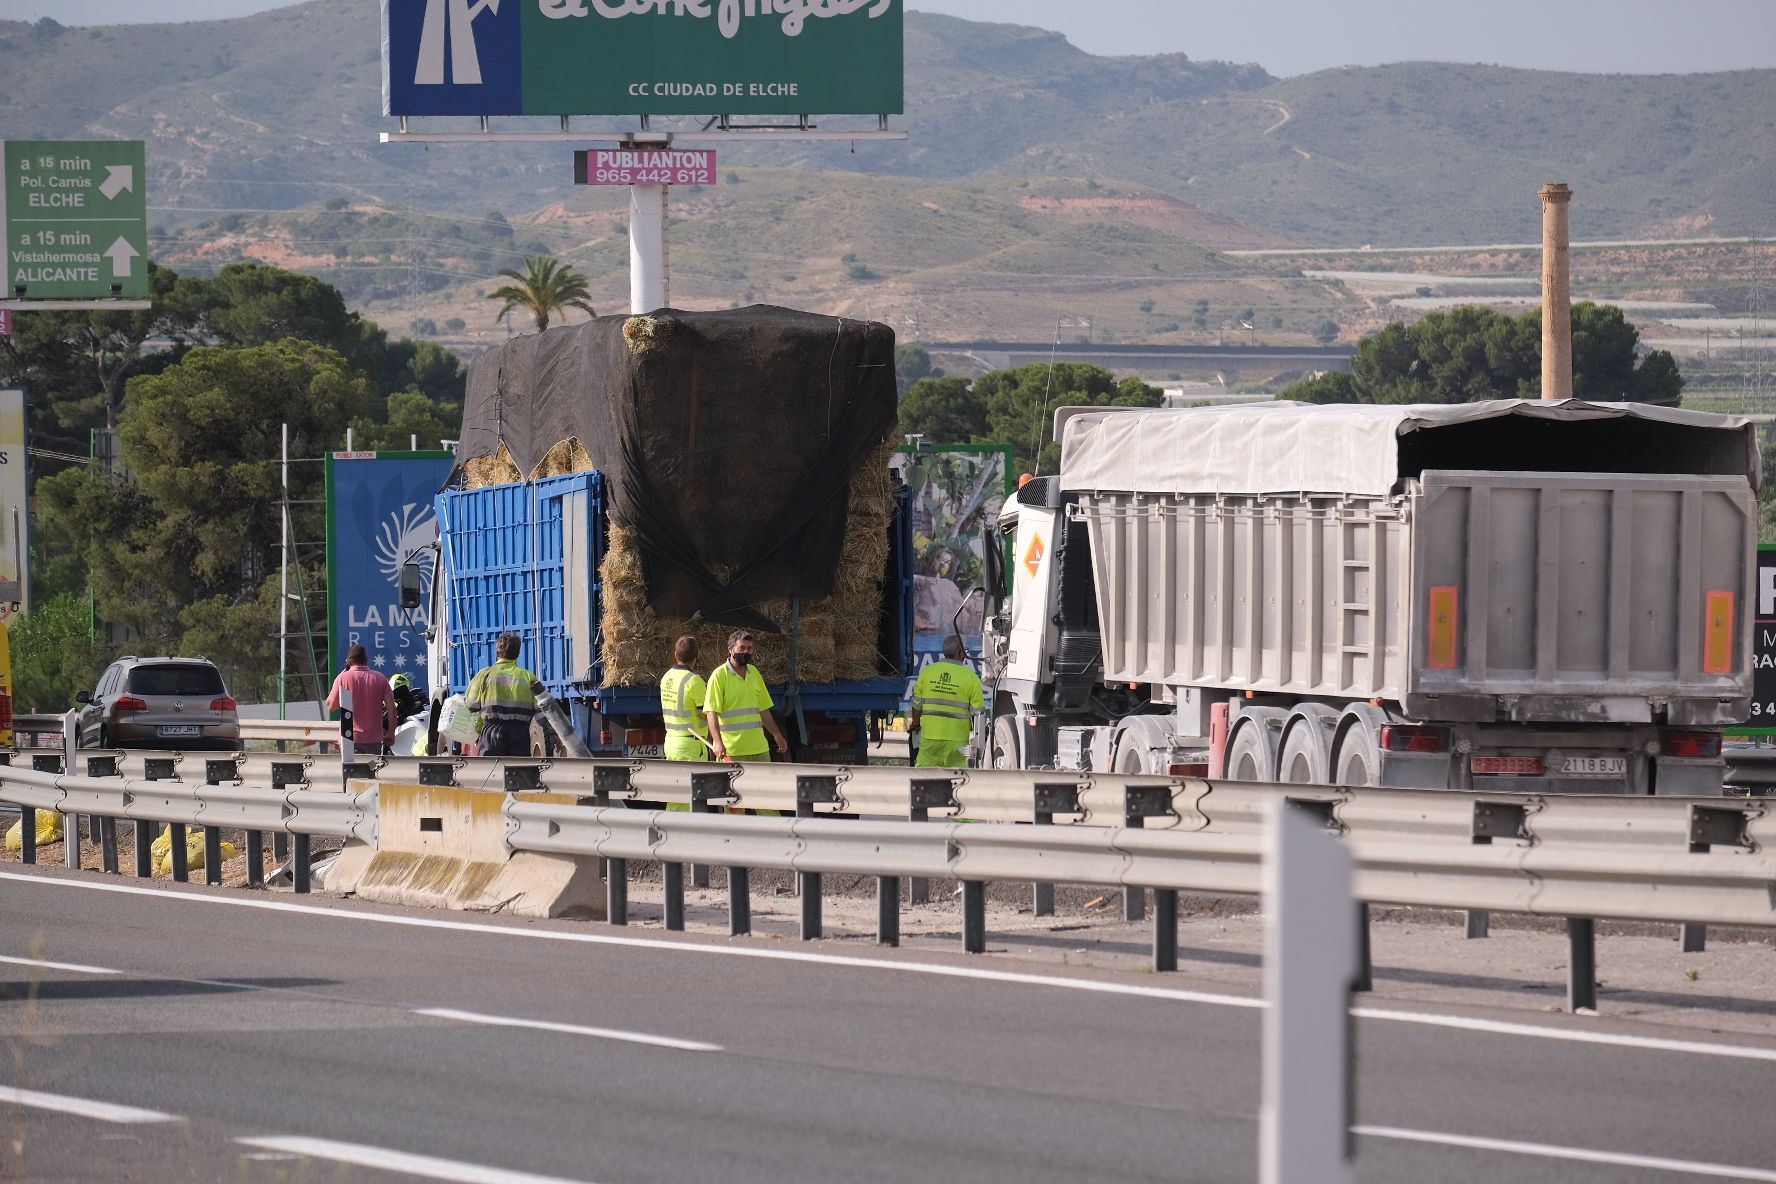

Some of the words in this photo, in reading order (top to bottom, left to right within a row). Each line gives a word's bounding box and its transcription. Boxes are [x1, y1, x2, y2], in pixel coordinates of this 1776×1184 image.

[628, 83, 649, 96] CC
[653, 83, 717, 96] CIUDAD
[723, 83, 744, 96] DE
[749, 83, 798, 96] ELCHE
[20, 159, 31, 170] a
[38, 157, 54, 168] 15
[60, 156, 91, 170] min
[597, 151, 708, 169] PUBLIANTON
[20, 176, 46, 188] Pol.
[48, 175, 92, 188] Carrús
[596, 170, 631, 183] 965
[636, 170, 672, 183] 442
[677, 170, 709, 183] 612
[29, 193, 85, 207] ELCHE
[20, 234, 31, 245] a
[36, 231, 55, 246] 15
[60, 231, 91, 245] min
[12, 251, 101, 263] Vistahermosa
[15, 268, 99, 282] ALICANTE
[348, 604, 383, 628] LA
[630, 745, 658, 756] 7448
[1563, 758, 1596, 771] 2118
[1599, 758, 1625, 771] BJV
